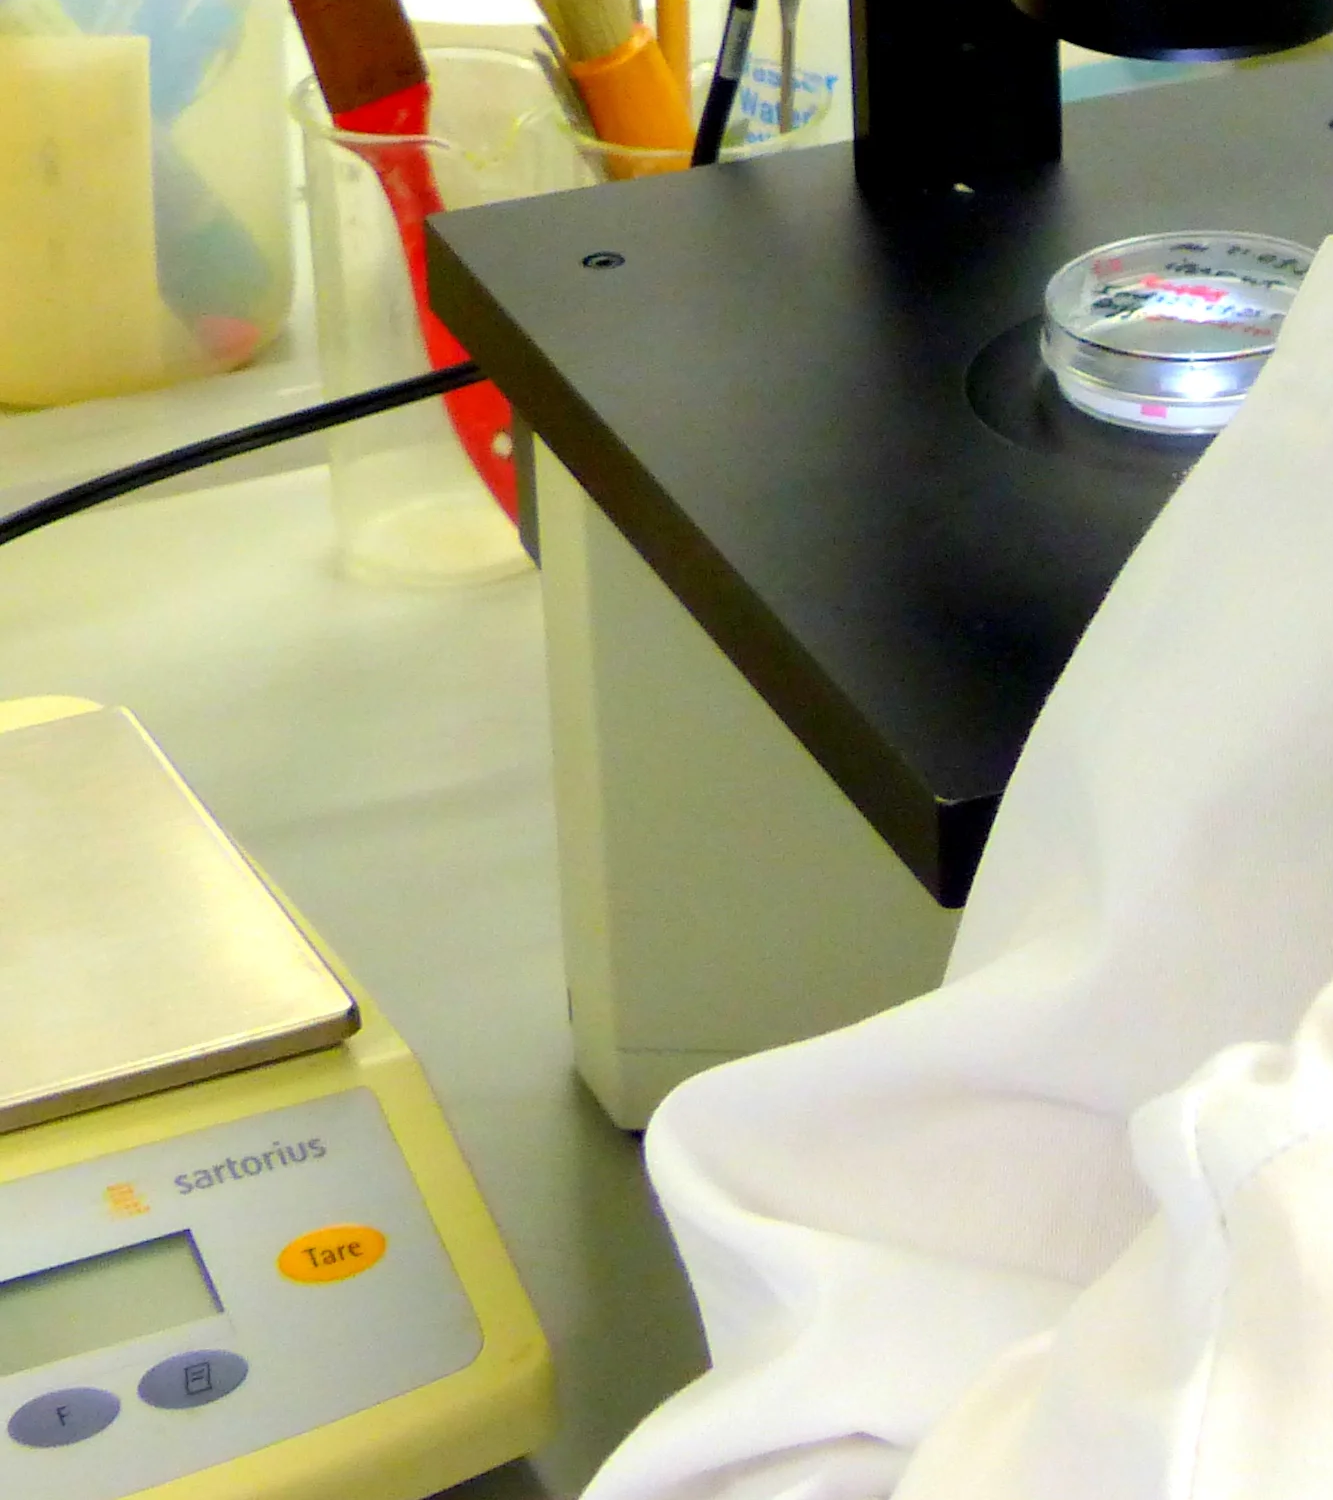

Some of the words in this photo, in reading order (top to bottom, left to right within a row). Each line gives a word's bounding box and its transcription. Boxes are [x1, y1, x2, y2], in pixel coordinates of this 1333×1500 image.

[174, 1134, 328, 1196] sartorius
[303, 1238, 365, 1269] Tare
[56, 1406, 70, 1427] F
